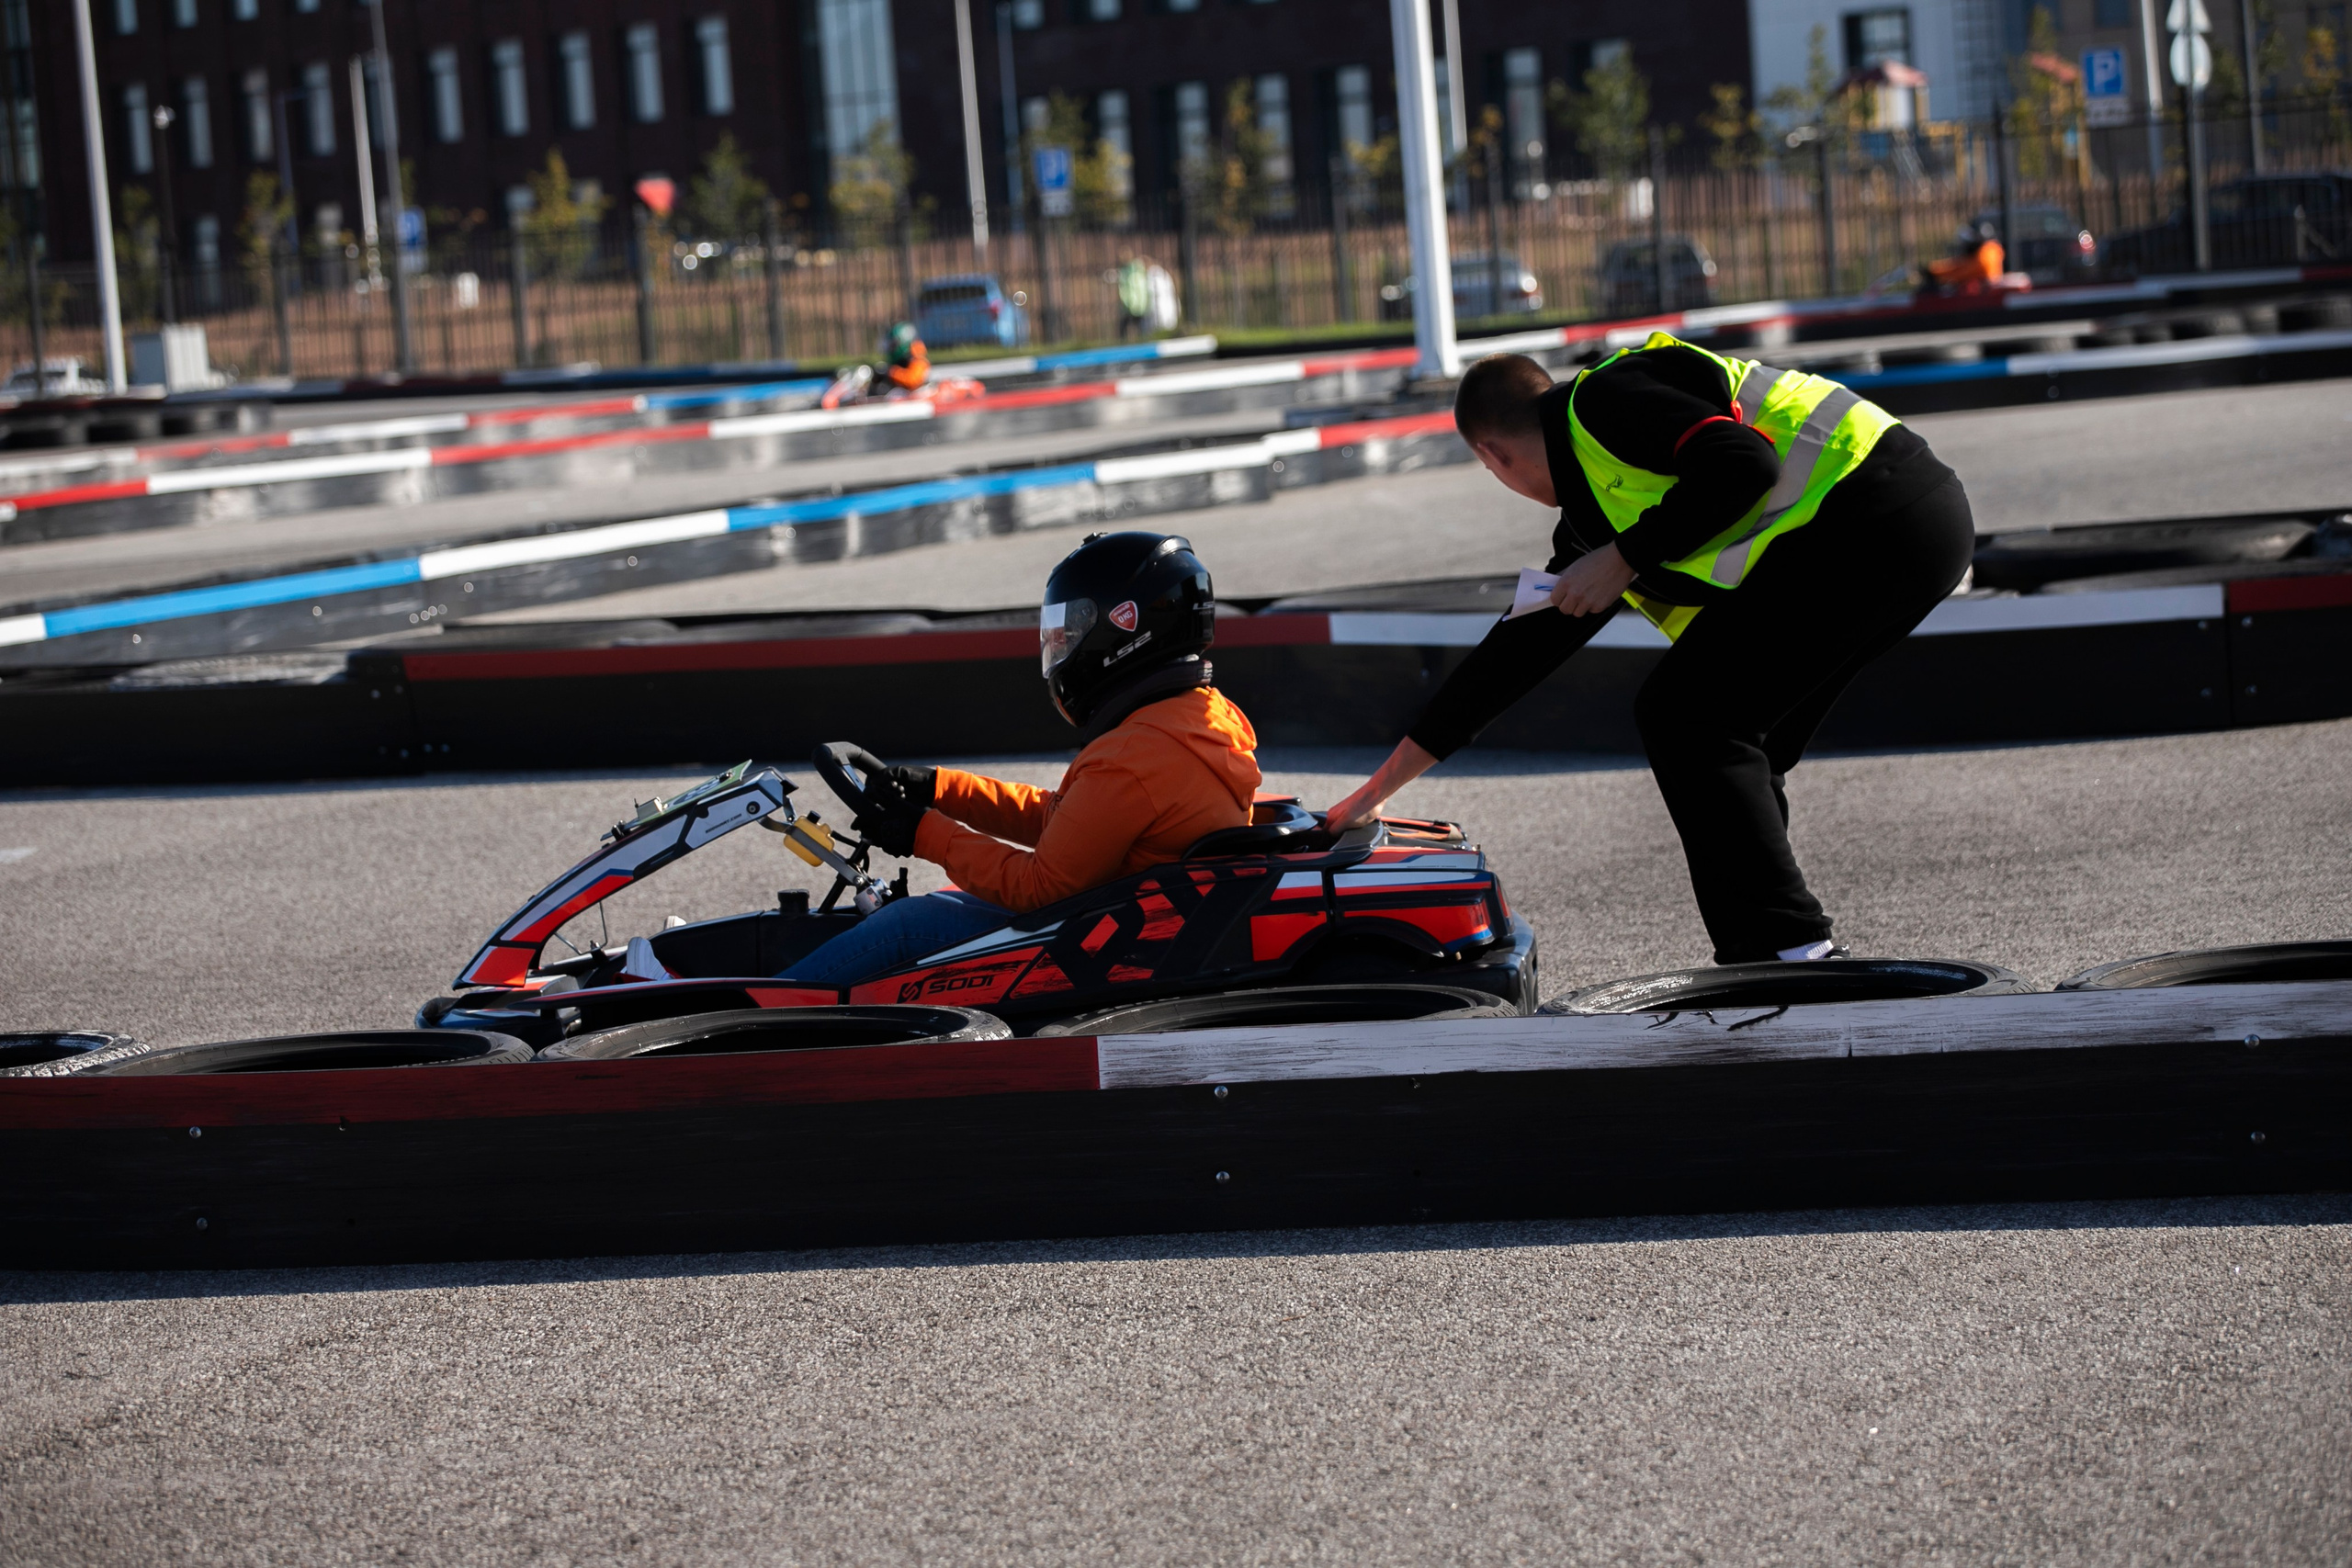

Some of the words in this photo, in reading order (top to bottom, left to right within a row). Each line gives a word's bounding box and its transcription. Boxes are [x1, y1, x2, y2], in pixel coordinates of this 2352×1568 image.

[2093, 50, 2120, 94] P
[1103, 631, 1152, 667] LS2
[927, 975, 995, 995] SODI
